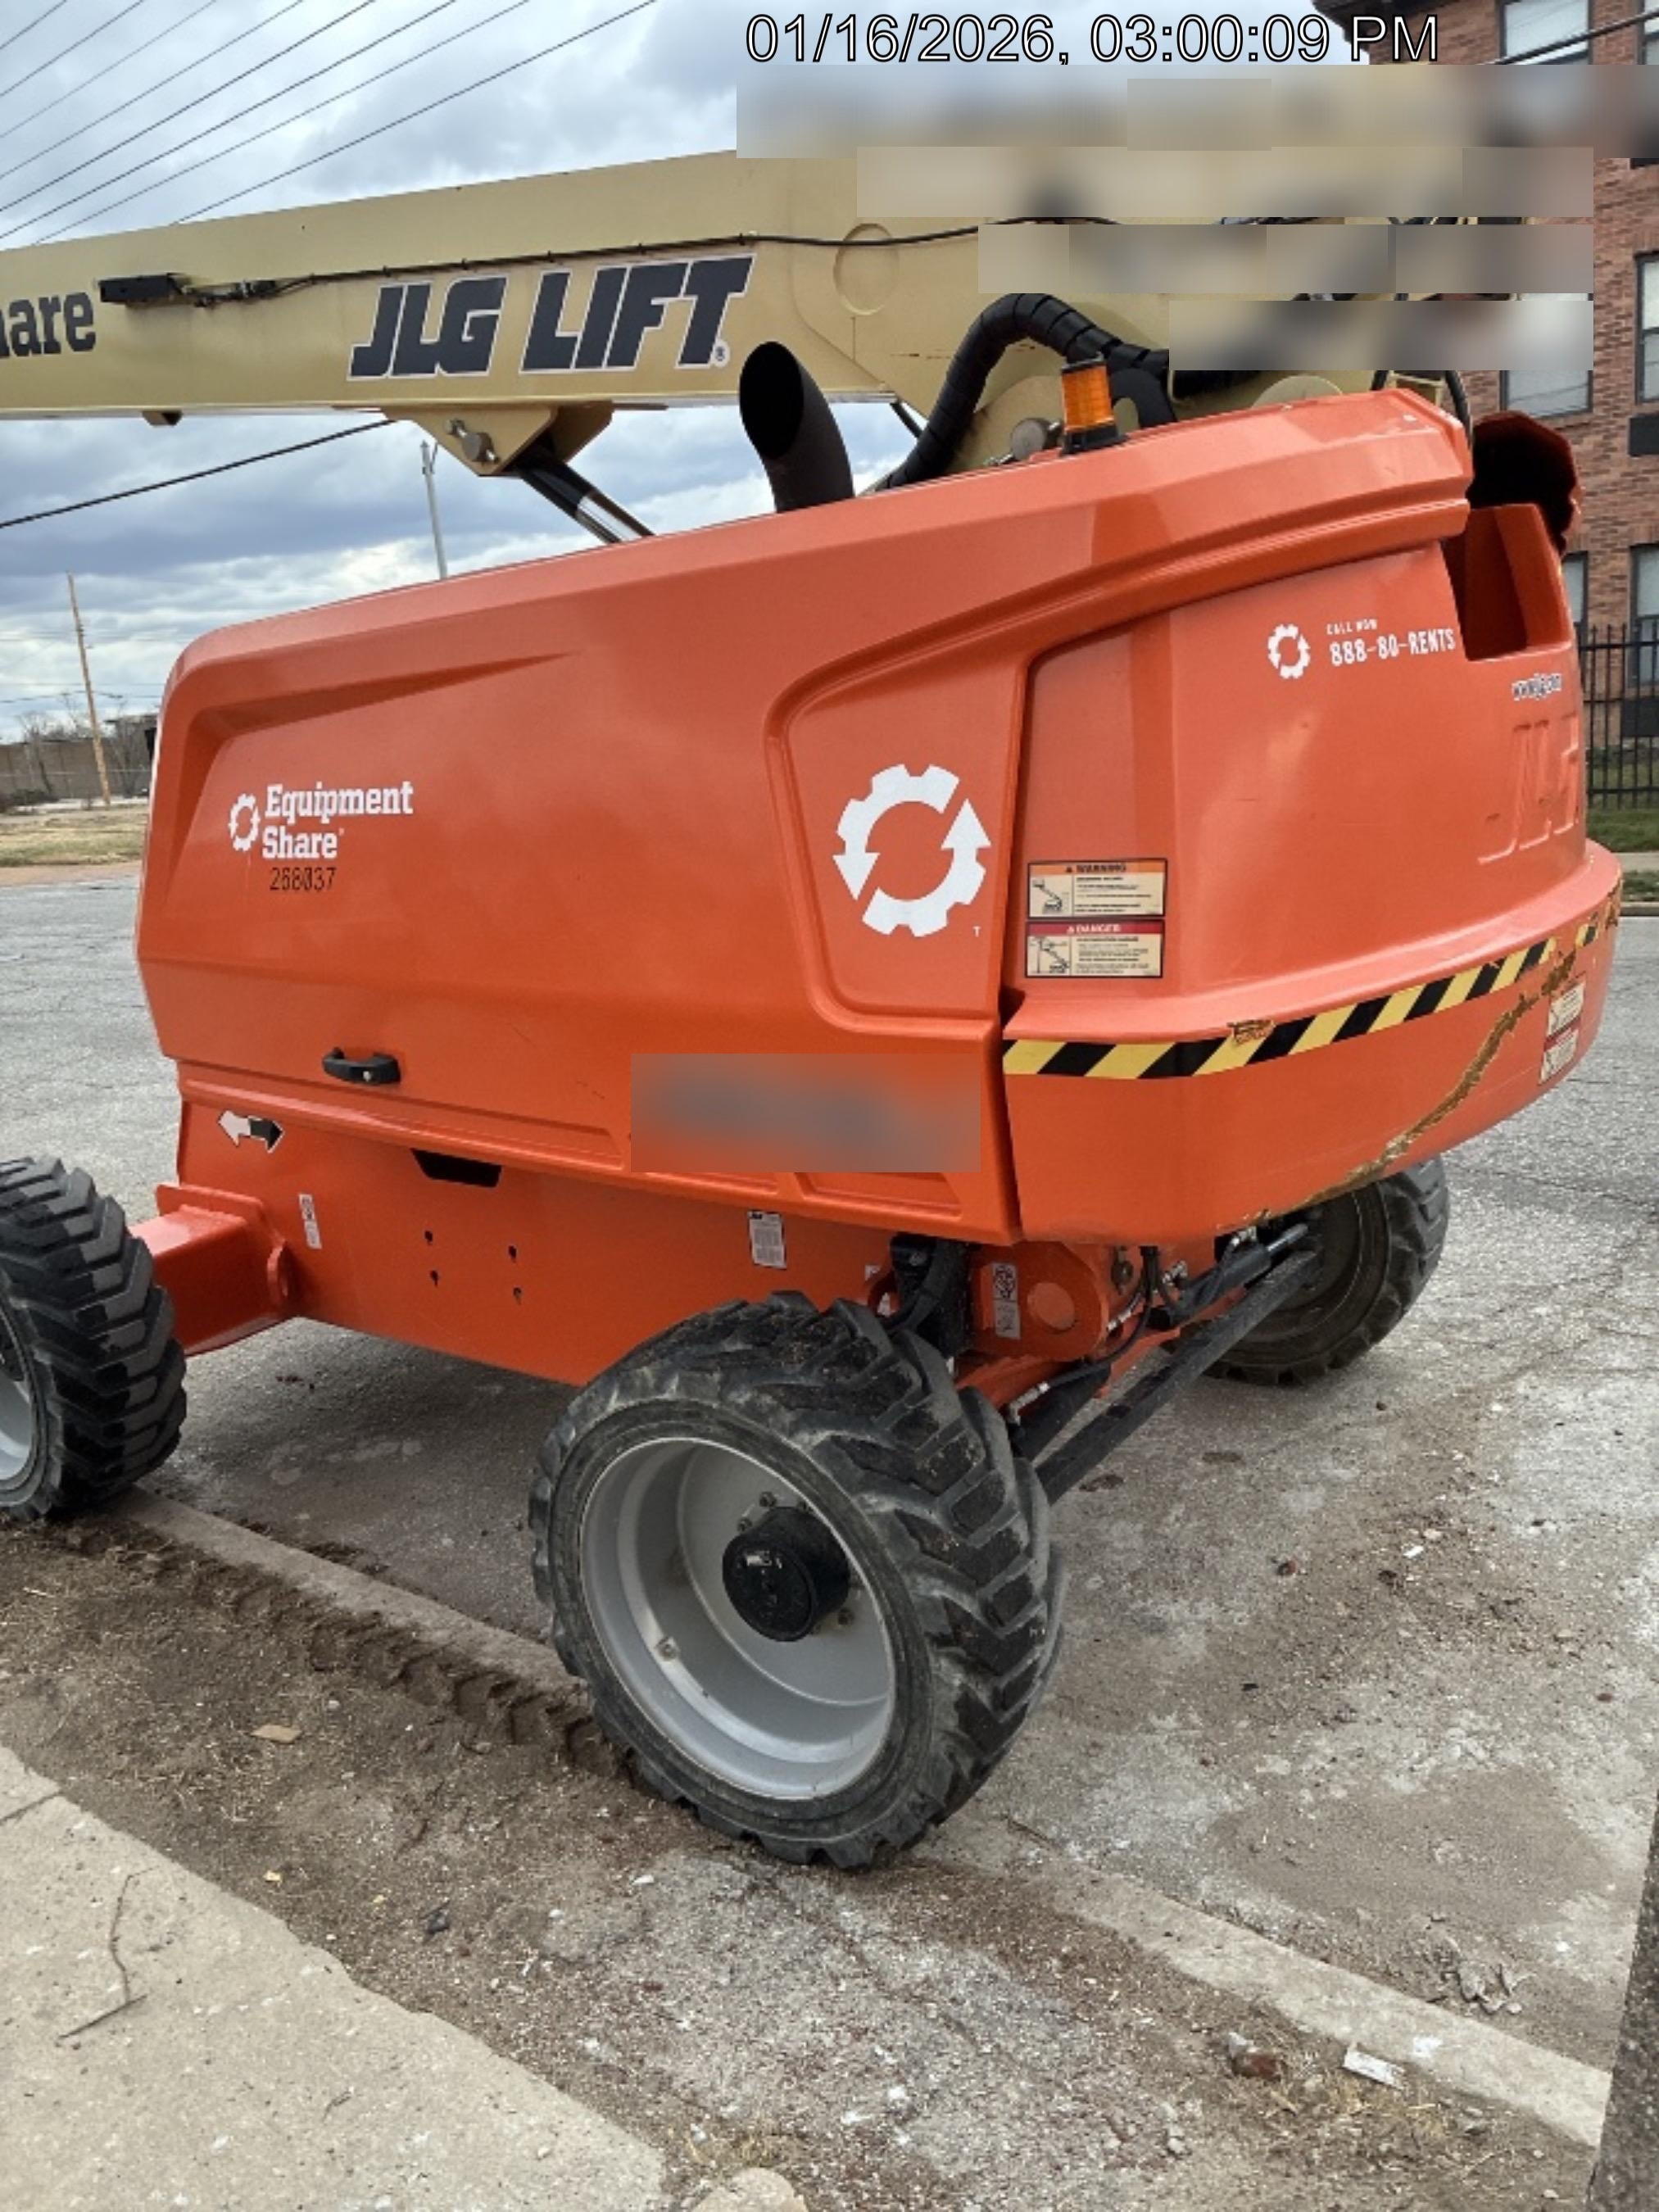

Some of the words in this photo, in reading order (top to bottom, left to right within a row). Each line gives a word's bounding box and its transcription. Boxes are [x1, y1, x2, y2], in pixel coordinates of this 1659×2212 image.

[347, 277, 508, 379] JLG
[1326, 623, 1353, 635] CALL
[1329, 628, 1457, 667] 888-80-RENTS
[264, 781, 415, 825] Equipment
[261, 824, 338, 859] Share
